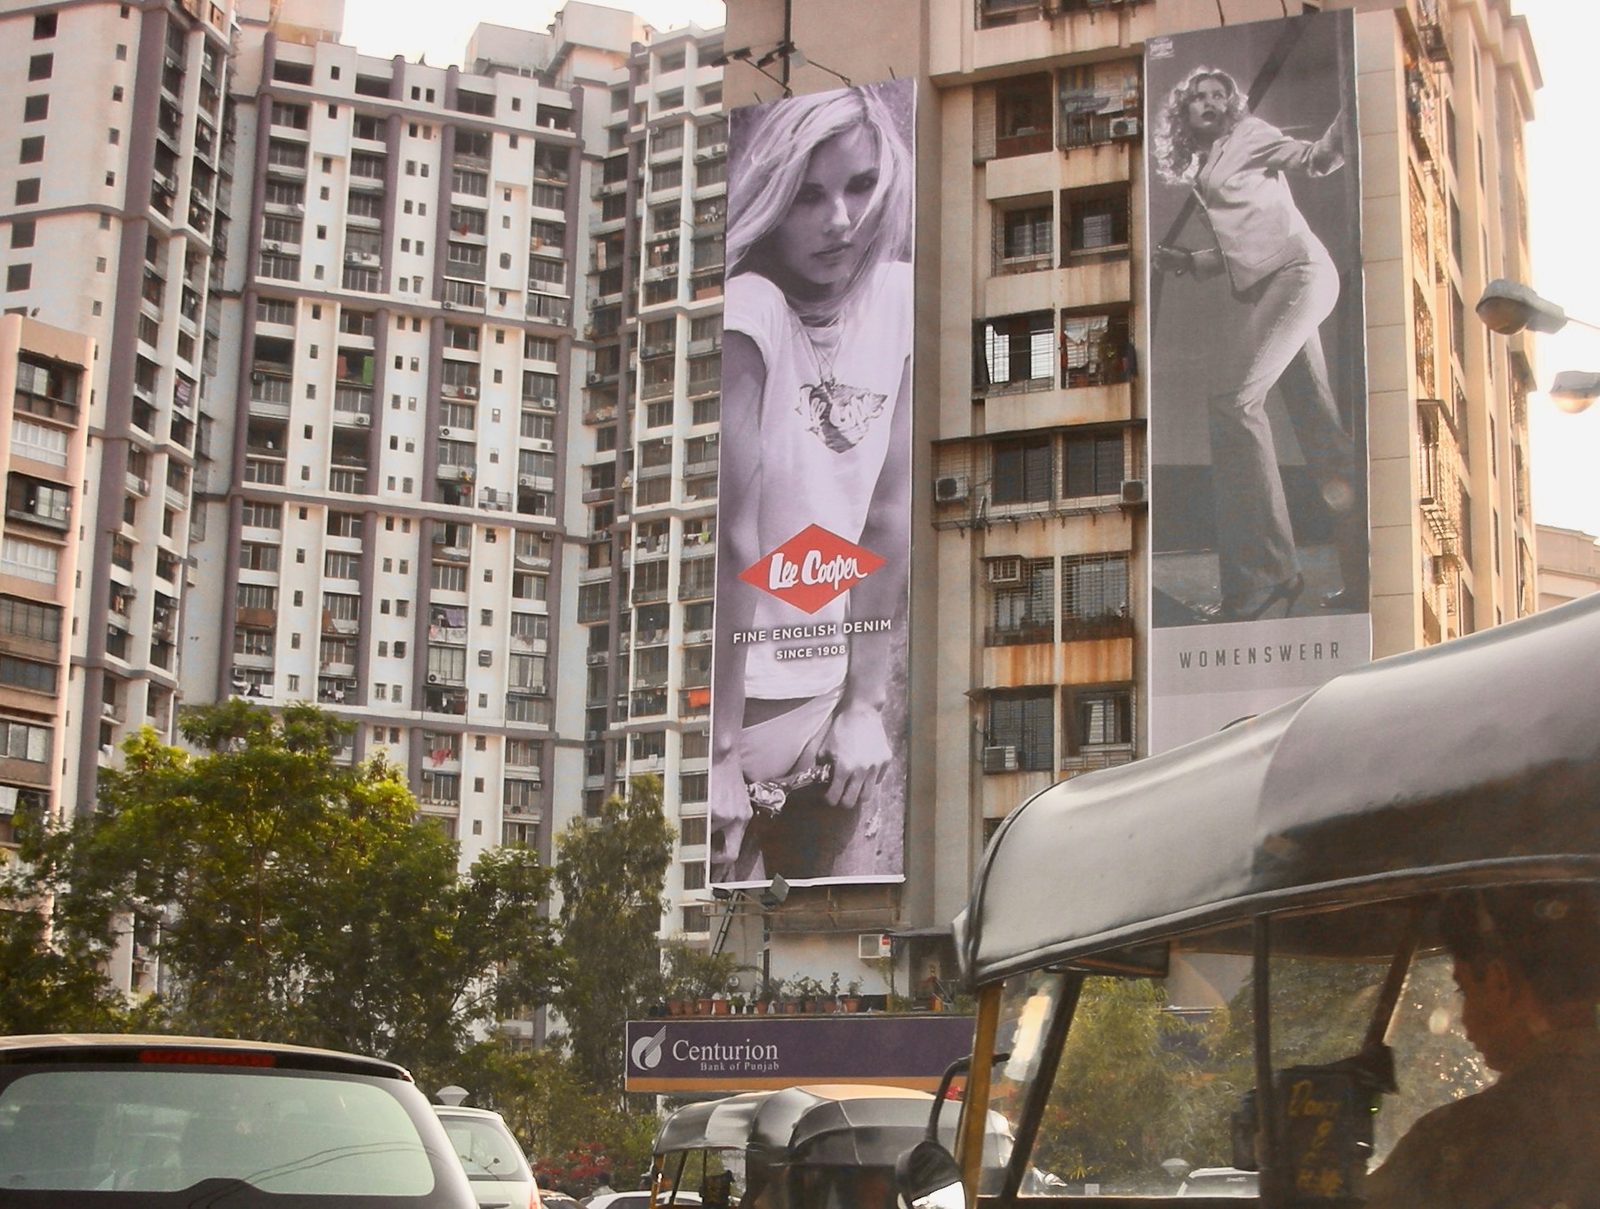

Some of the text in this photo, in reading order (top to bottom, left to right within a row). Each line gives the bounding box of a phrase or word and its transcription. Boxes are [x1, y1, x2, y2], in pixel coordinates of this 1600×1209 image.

[769, 550, 868, 590] Lee Cooper
[733, 619, 892, 644] FINE ENGLISH DENIM
[776, 645, 846, 660] SINCE 1908
[1179, 642, 1340, 669] WOMENSWEAR
[672, 1038, 779, 1061] Centurion
[700, 1061, 780, 1072] Bank of Punjab
